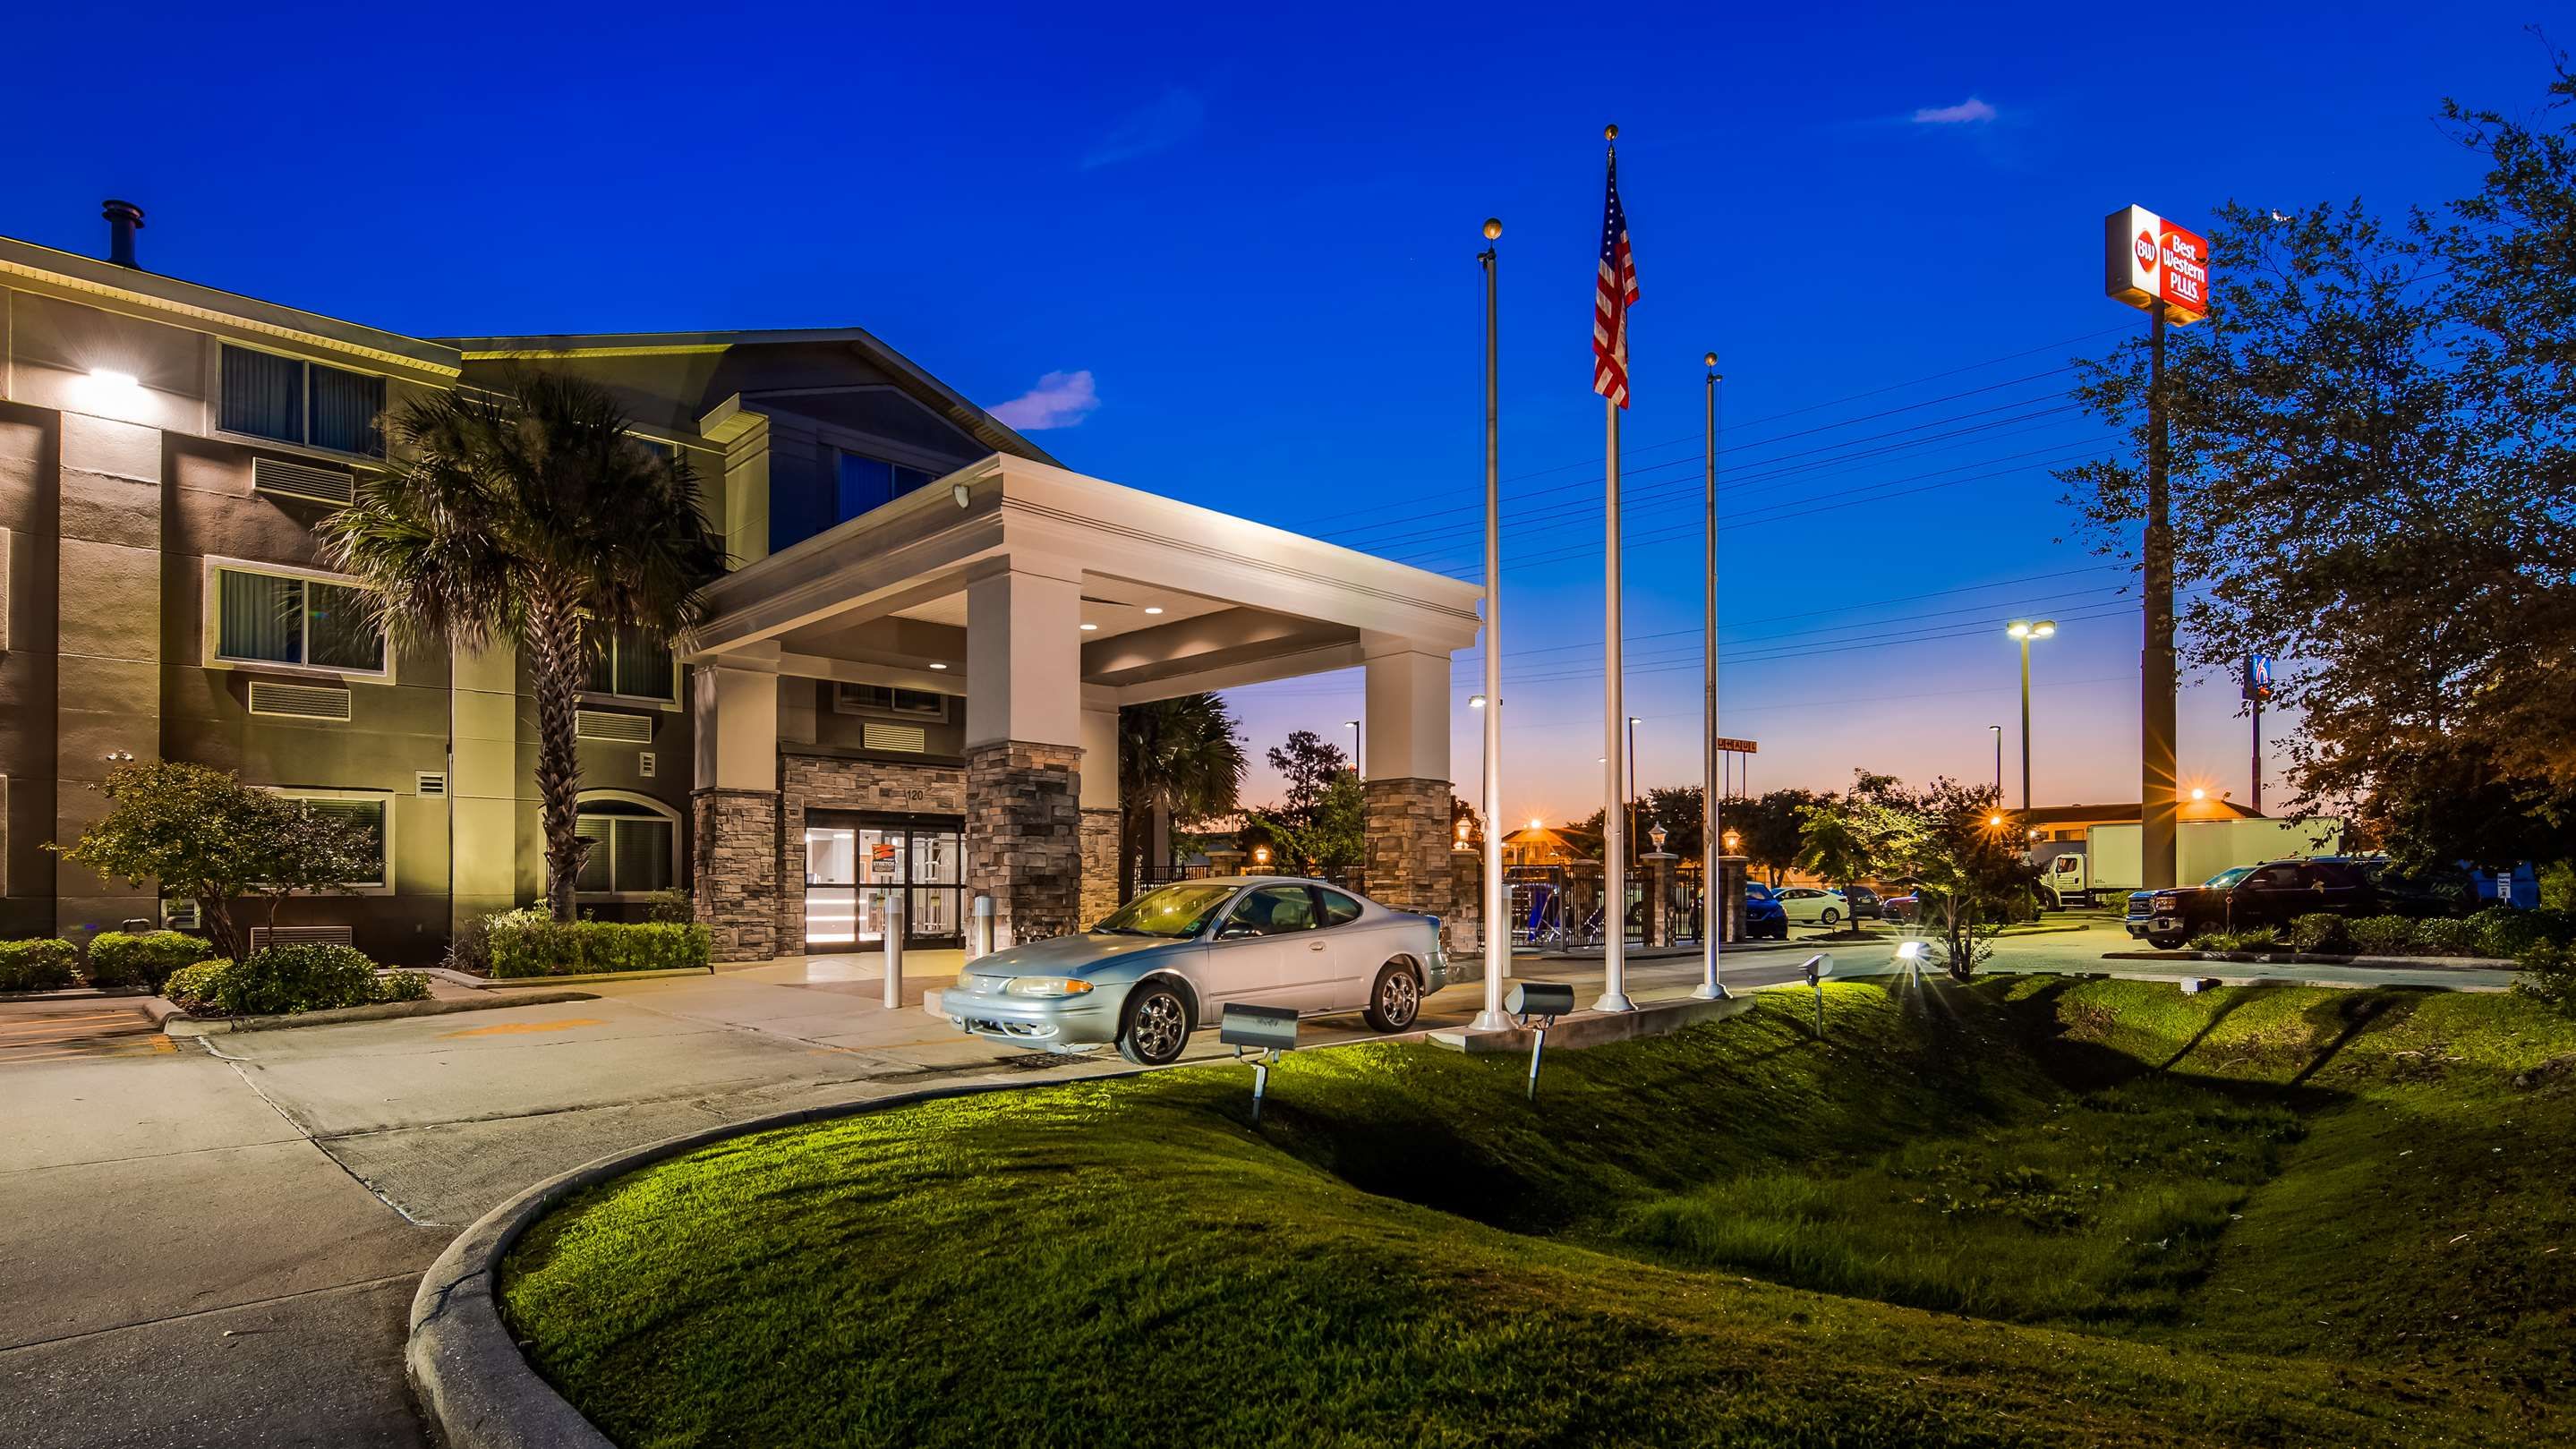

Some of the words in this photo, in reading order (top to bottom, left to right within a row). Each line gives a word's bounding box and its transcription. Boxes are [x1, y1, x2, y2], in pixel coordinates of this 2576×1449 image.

[2137, 239, 2155, 261] BW
[2172, 234, 2196, 260] Best
[2162, 247, 2205, 283] Western
[907, 789, 923, 800] 120
